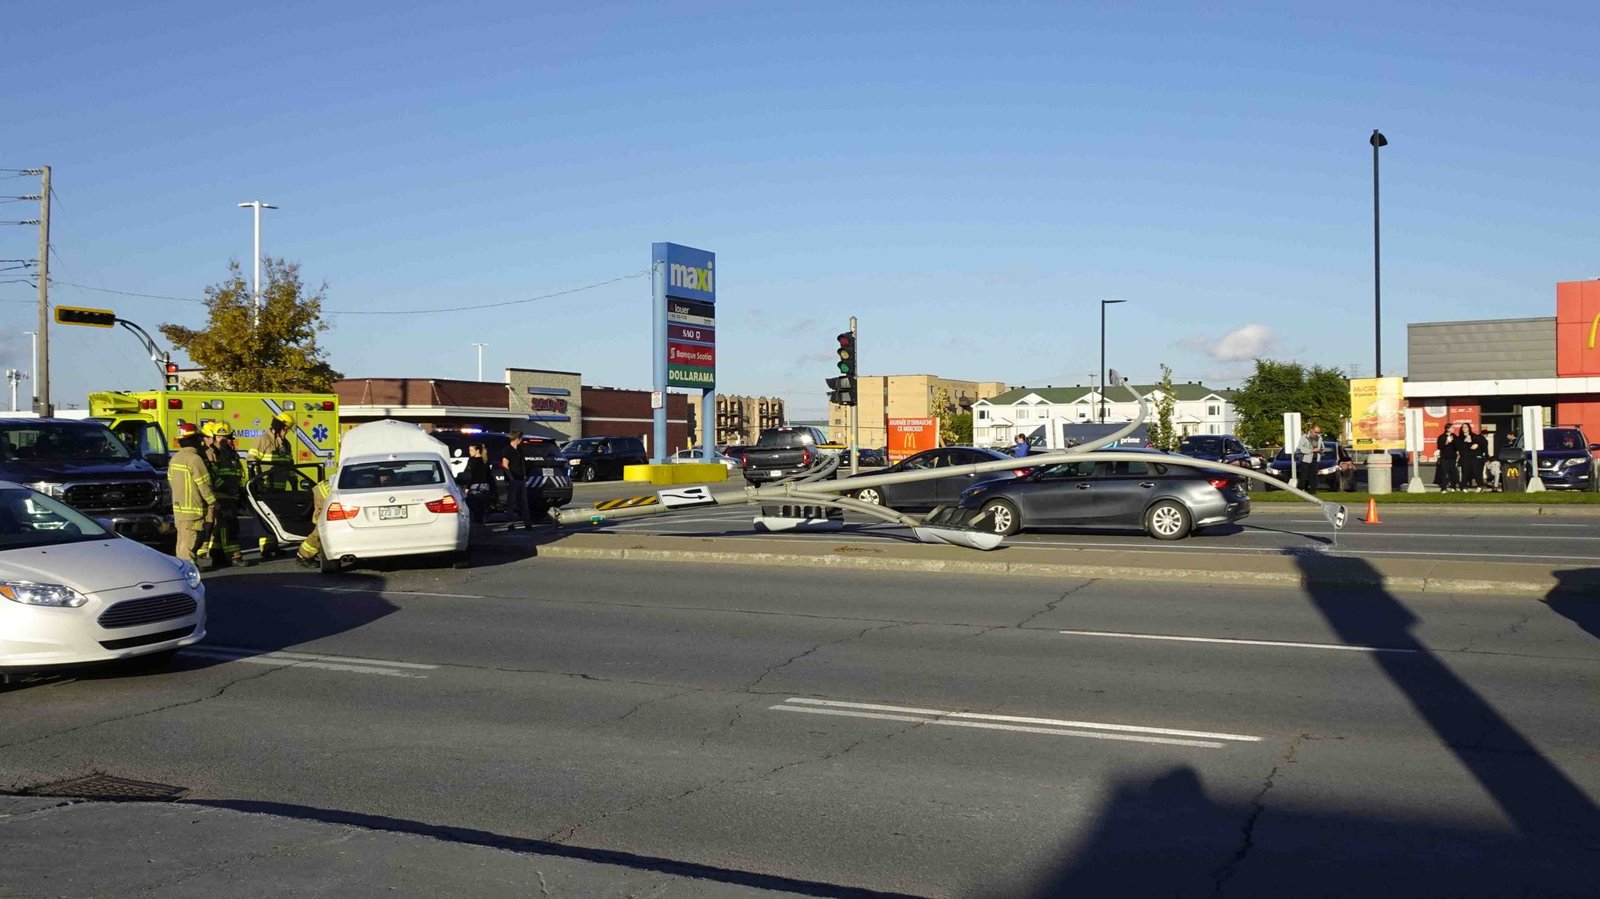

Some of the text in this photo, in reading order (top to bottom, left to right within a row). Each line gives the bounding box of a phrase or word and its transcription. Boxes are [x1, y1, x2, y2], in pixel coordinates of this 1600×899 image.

[670, 260, 713, 293] maxi
[674, 303, 690, 315] louer
[682, 329, 695, 339] SAQ
[676, 350, 697, 360] Banque
[696, 352, 712, 361] Scotia
[669, 369, 714, 382] DOLLARAMA
[1120, 437, 1141, 445] prime
